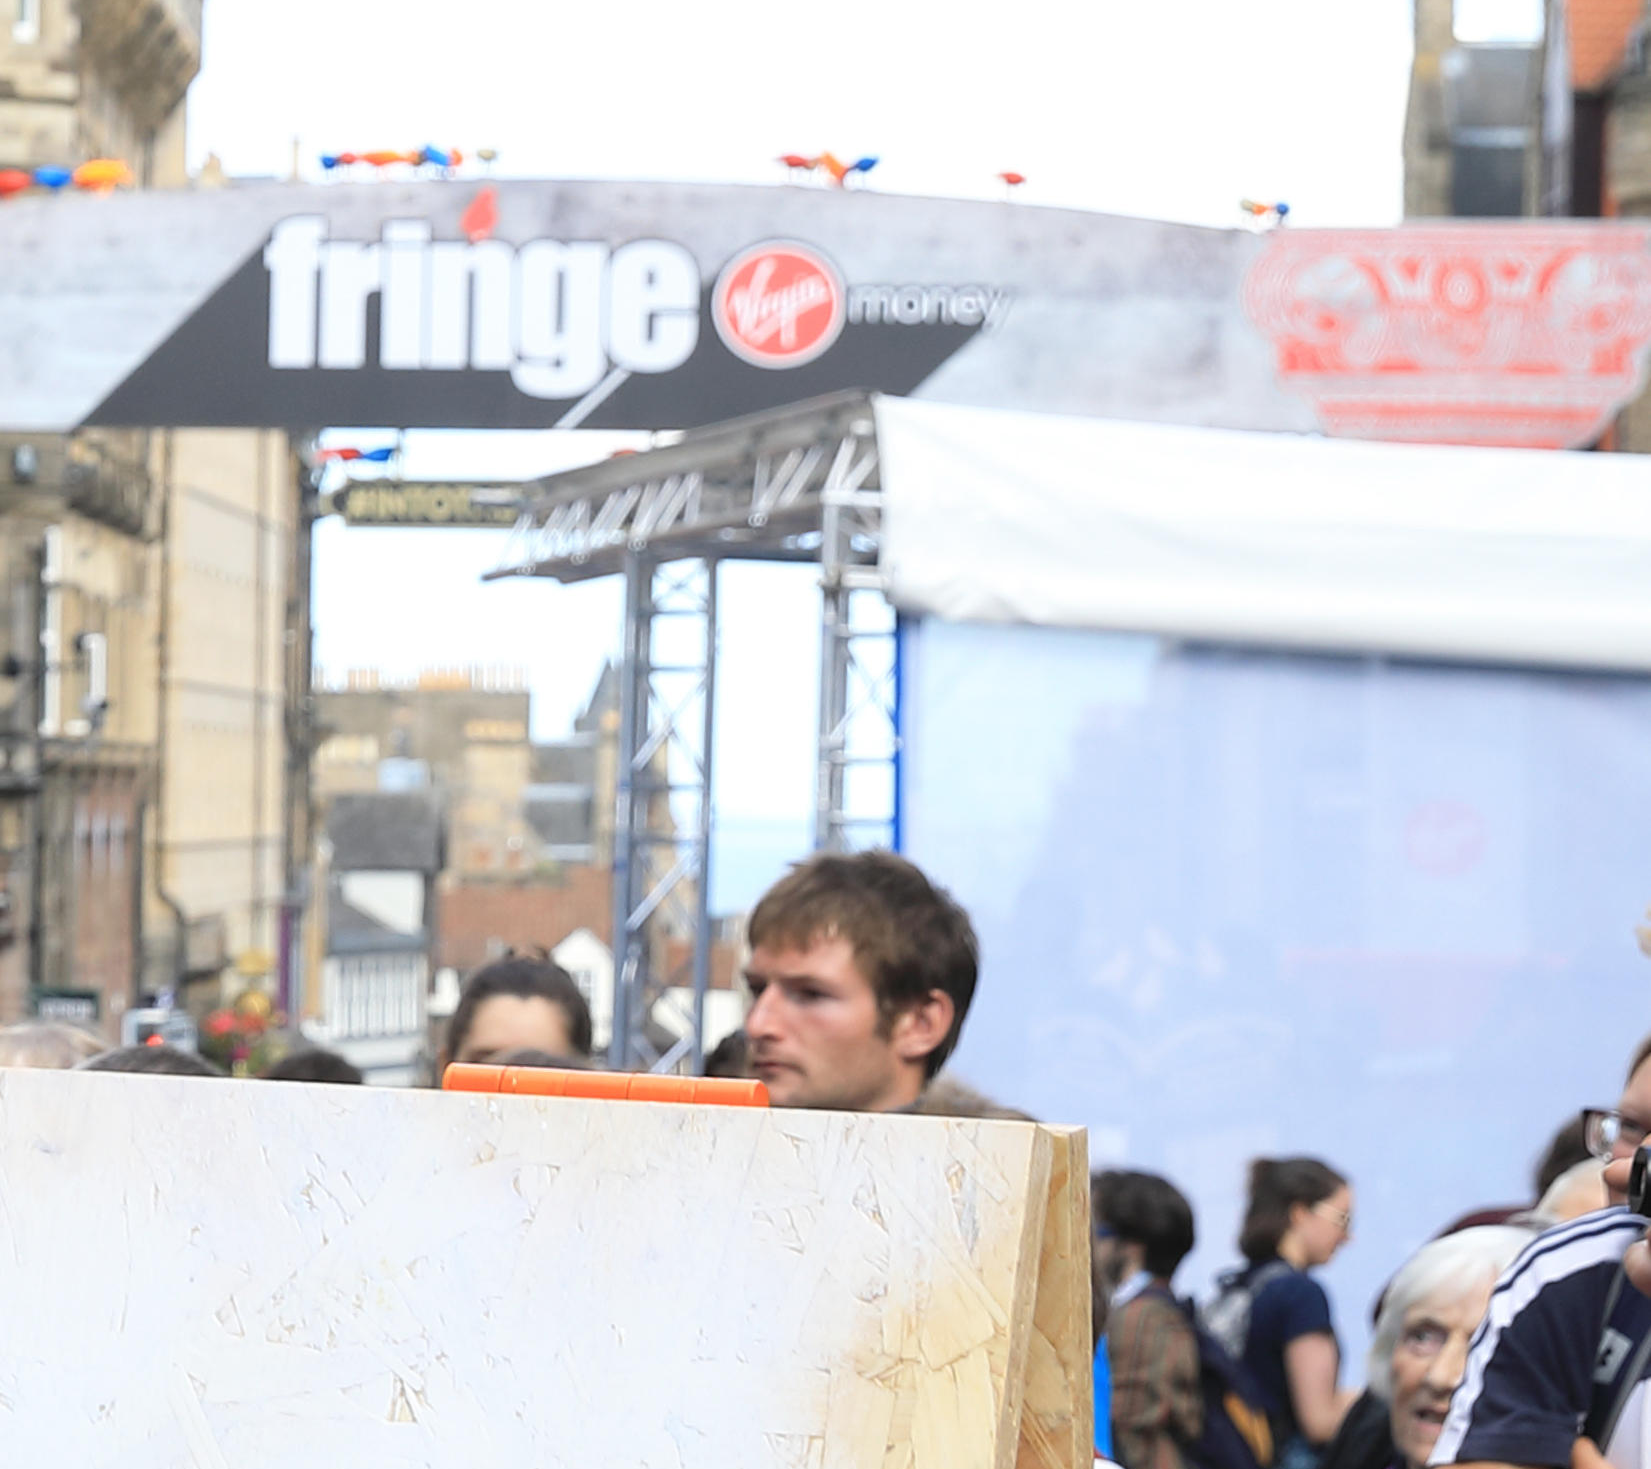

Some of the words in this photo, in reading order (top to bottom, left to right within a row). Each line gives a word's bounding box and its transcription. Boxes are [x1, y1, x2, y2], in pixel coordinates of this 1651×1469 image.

[264, 213, 700, 400] fringe
[727, 256, 832, 349] Virgin
[849, 282, 1011, 330] money
